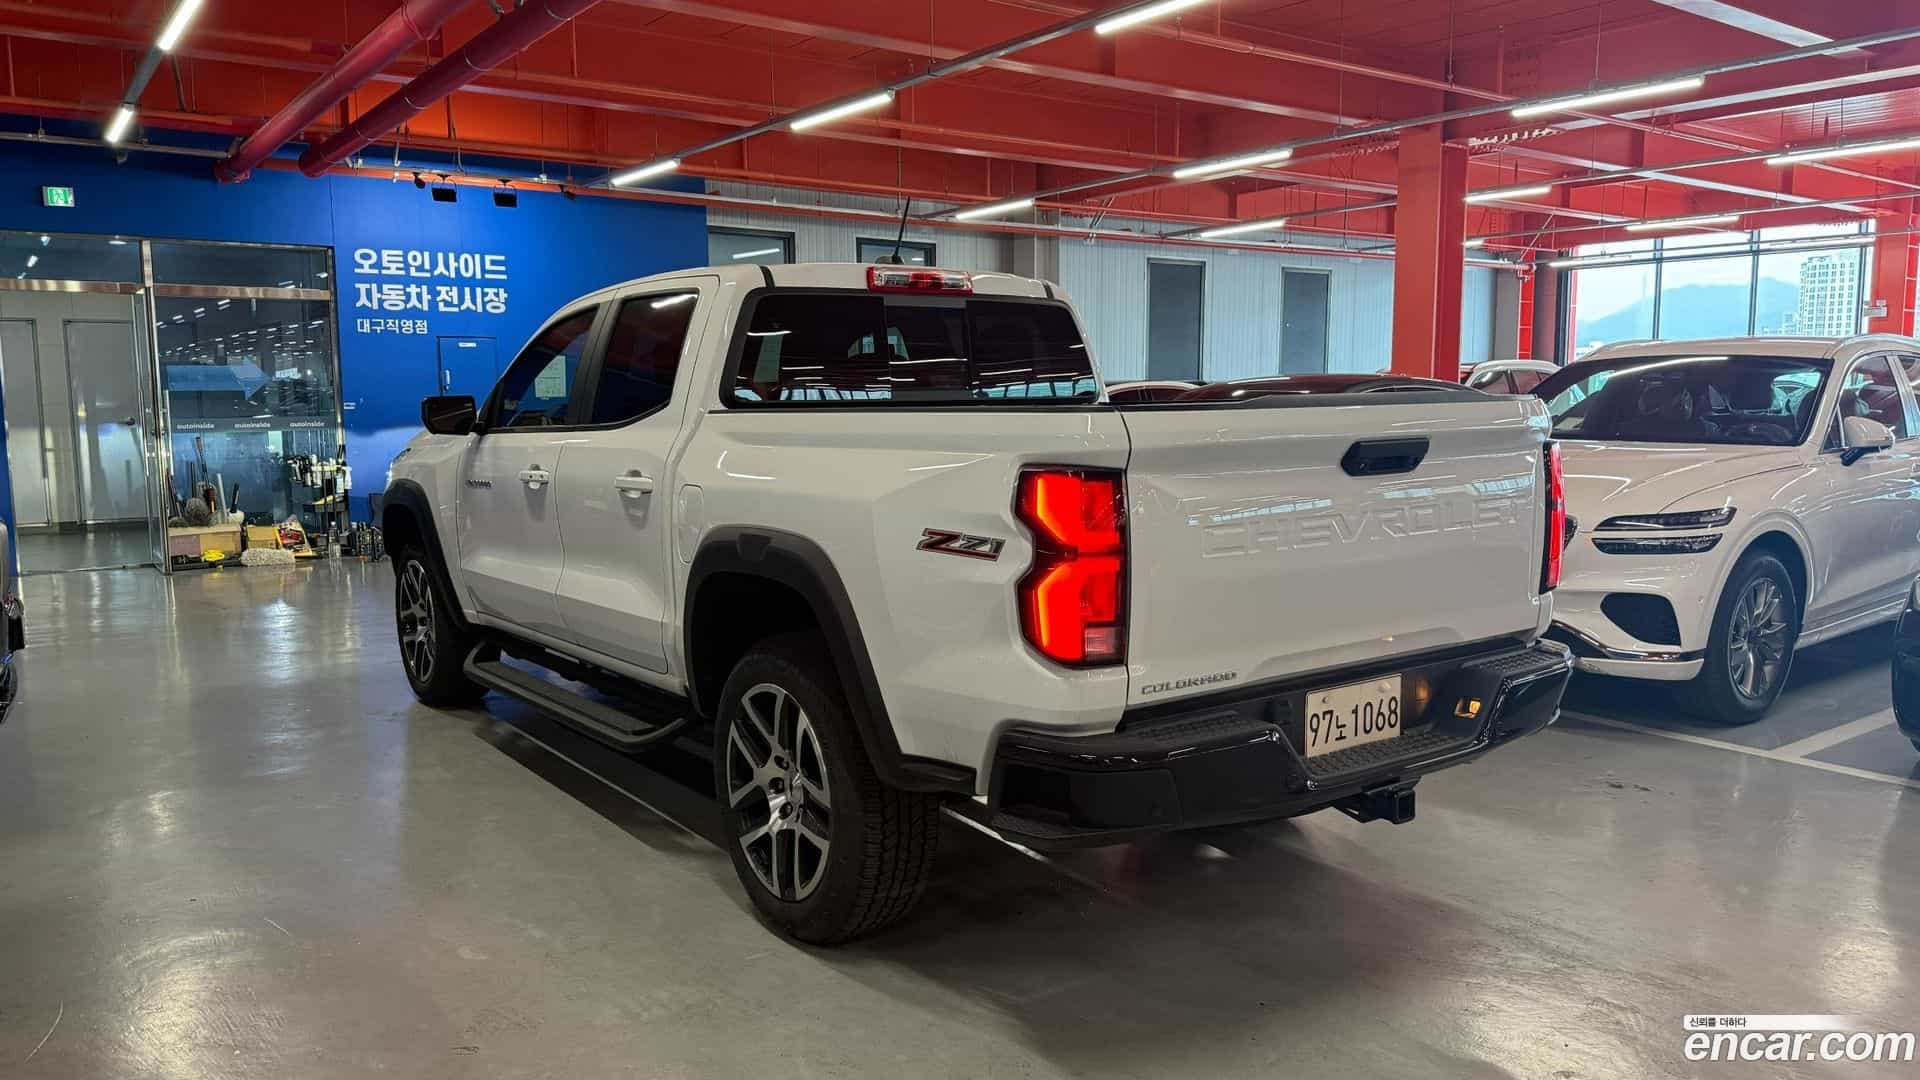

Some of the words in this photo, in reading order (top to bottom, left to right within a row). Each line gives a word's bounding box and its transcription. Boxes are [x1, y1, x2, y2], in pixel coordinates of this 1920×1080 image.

[353, 248, 508, 280] 오토인사이드
[354, 283, 432, 311] 자동차
[436, 285, 508, 313] 전시장
[356, 318, 429, 335] 대구직영점
[916, 527, 1006, 562] Z71
[1141, 670, 1237, 696] COLORADO
